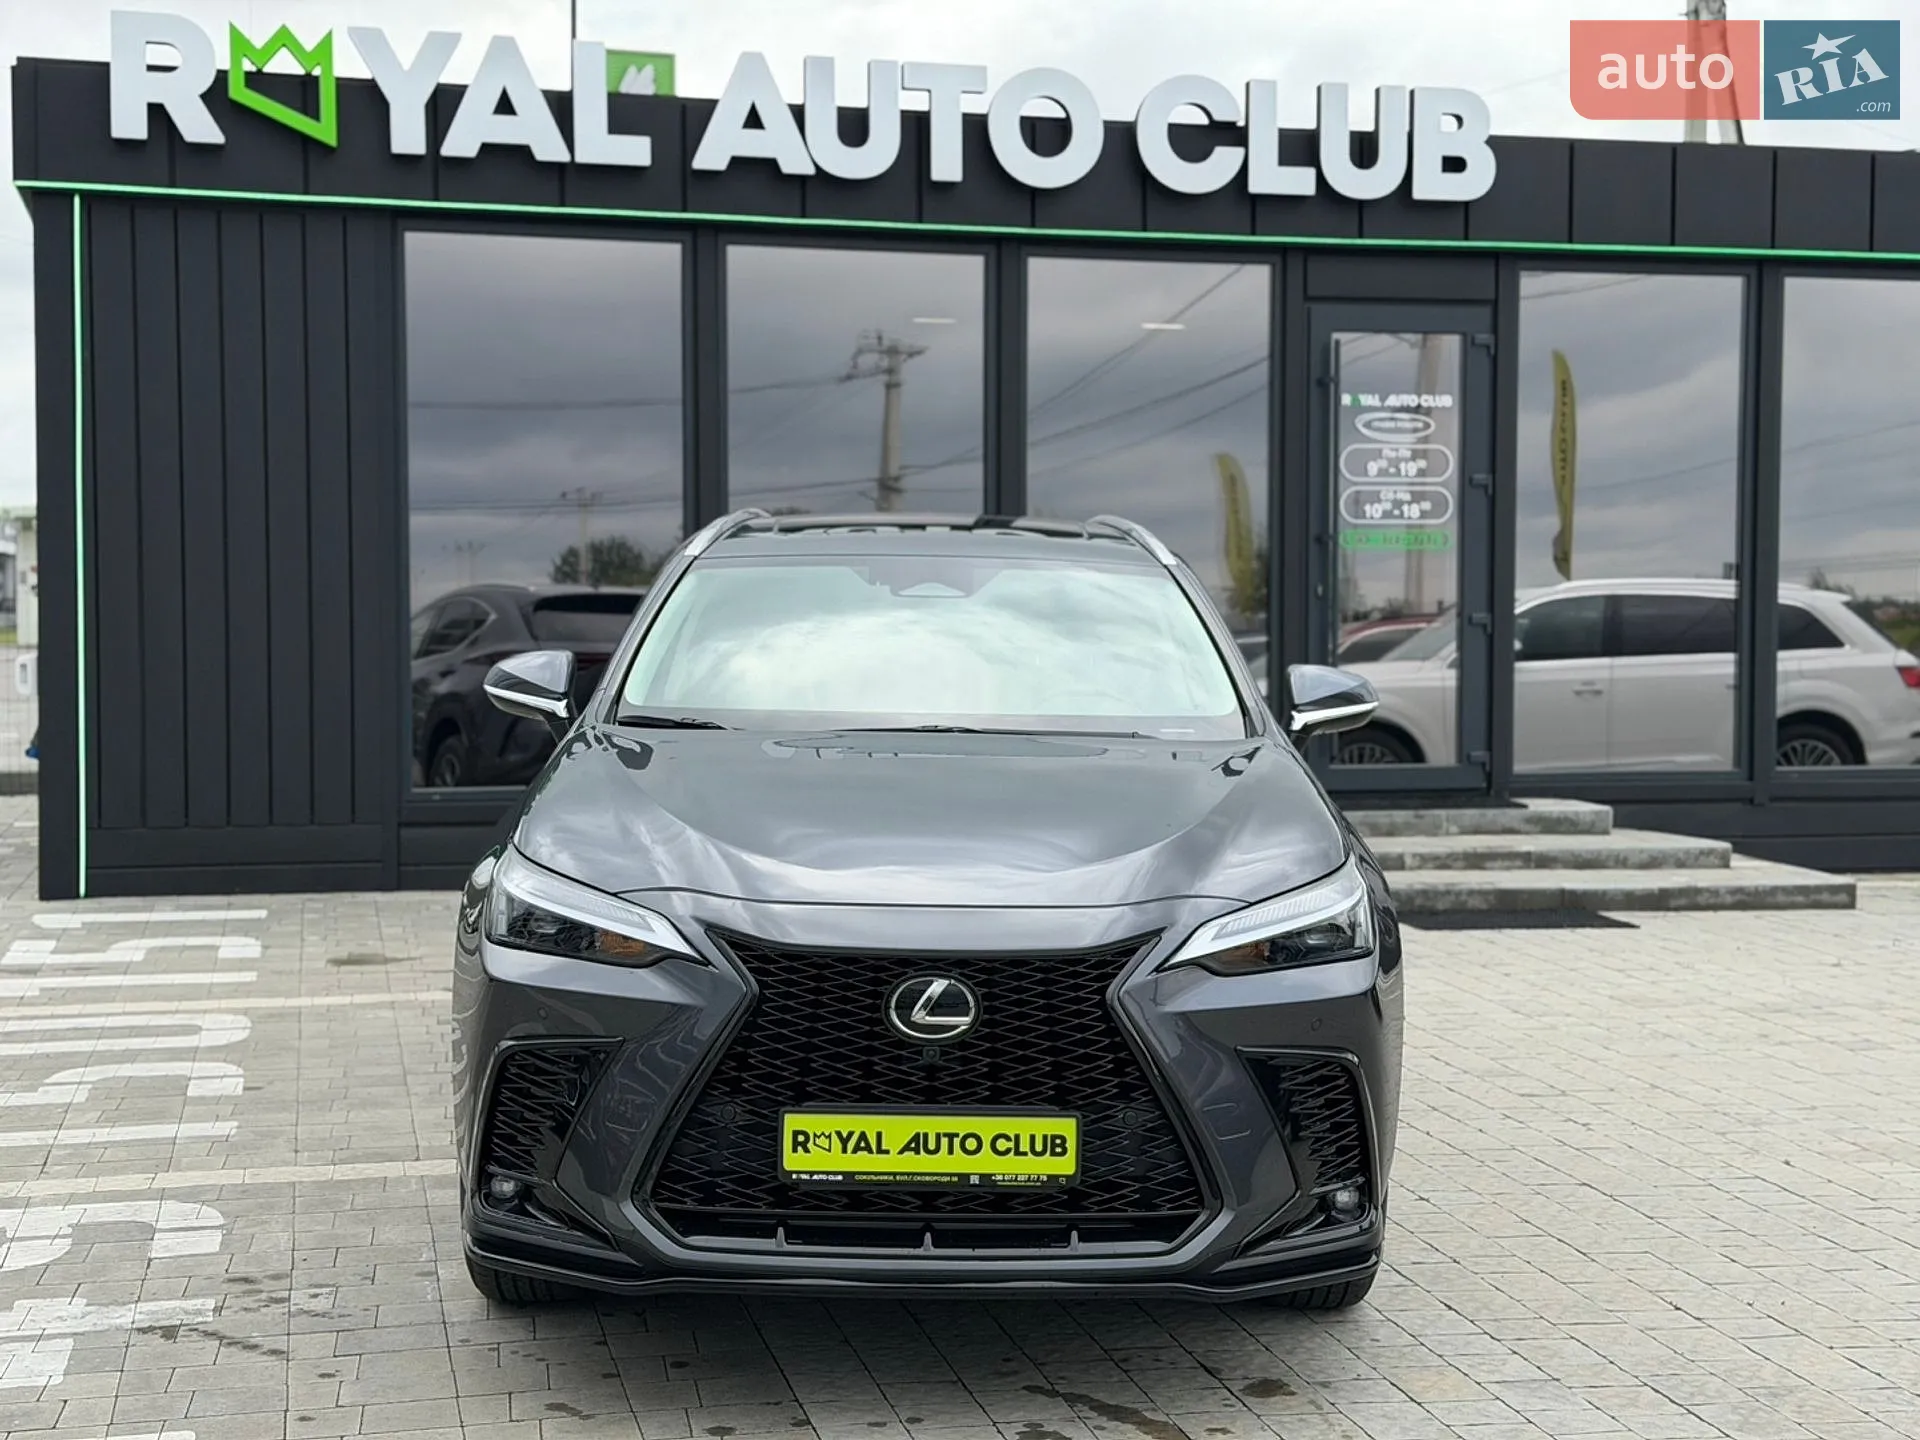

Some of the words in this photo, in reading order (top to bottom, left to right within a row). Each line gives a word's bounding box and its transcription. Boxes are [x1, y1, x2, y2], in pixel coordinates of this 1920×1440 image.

[691, 51, 1105, 189] AUTO
[1136, 74, 1497, 202] CLUB
[1384, 393, 1419, 408] AUTO
[1420, 393, 1454, 408] CLUB
[896, 1131, 984, 1157] AUTO
[989, 1133, 1069, 1158] CLUB
